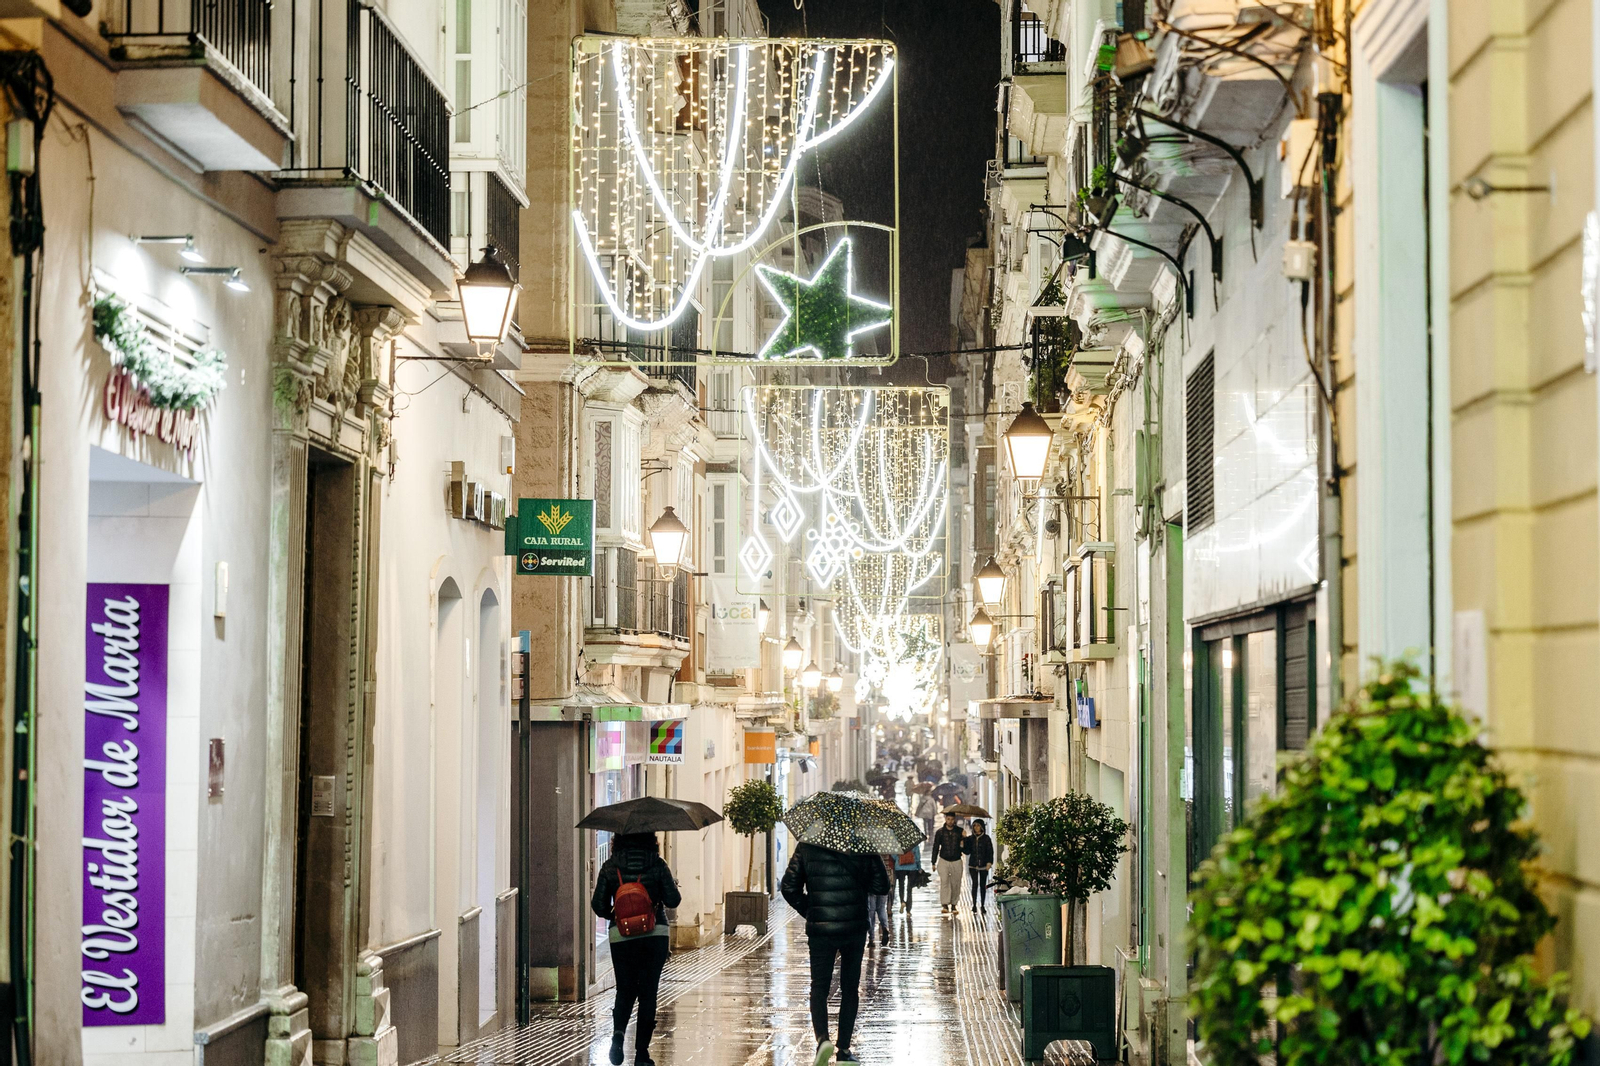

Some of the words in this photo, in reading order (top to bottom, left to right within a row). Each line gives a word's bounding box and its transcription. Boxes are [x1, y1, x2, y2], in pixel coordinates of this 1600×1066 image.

[524, 537, 548, 545] CAJA
[551, 537, 584, 546] RURAL
[541, 556, 586, 567] ServiRed
[83, 595, 140, 731] Marta
[83, 739, 138, 787] de
[649, 755, 682, 763] NAUTALIA
[80, 795, 138, 960] Vestidor
[80, 967, 138, 1013] El
